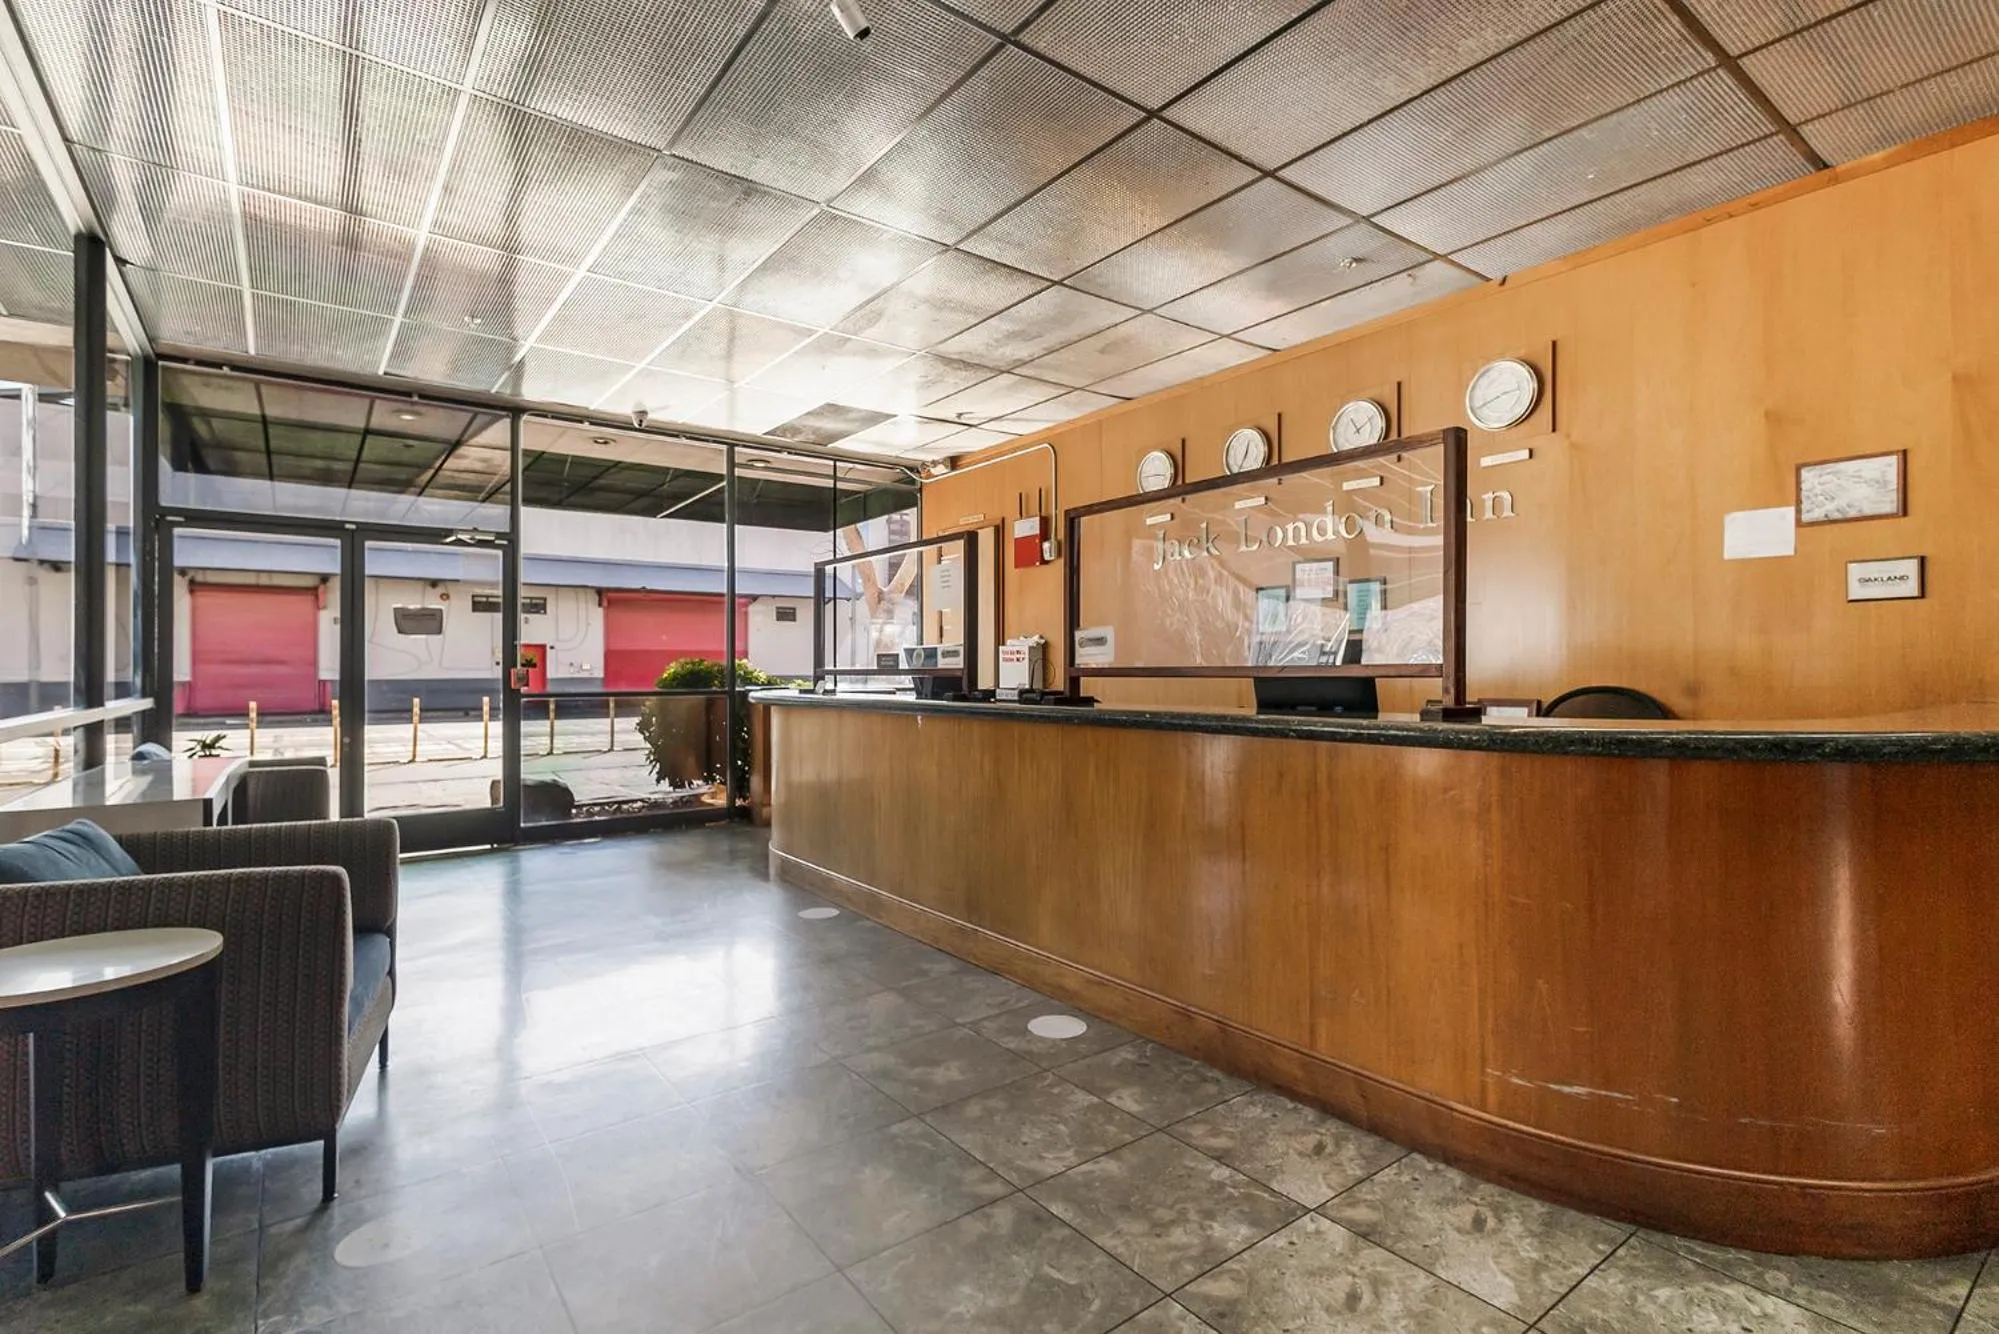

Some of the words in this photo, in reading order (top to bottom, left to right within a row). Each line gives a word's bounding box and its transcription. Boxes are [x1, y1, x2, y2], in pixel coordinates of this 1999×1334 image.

[1153, 519, 1222, 571] Jack
[1237, 499, 1396, 553] London
[1415, 483, 1517, 529] In
[1857, 574, 1909, 583] OAKLAND
